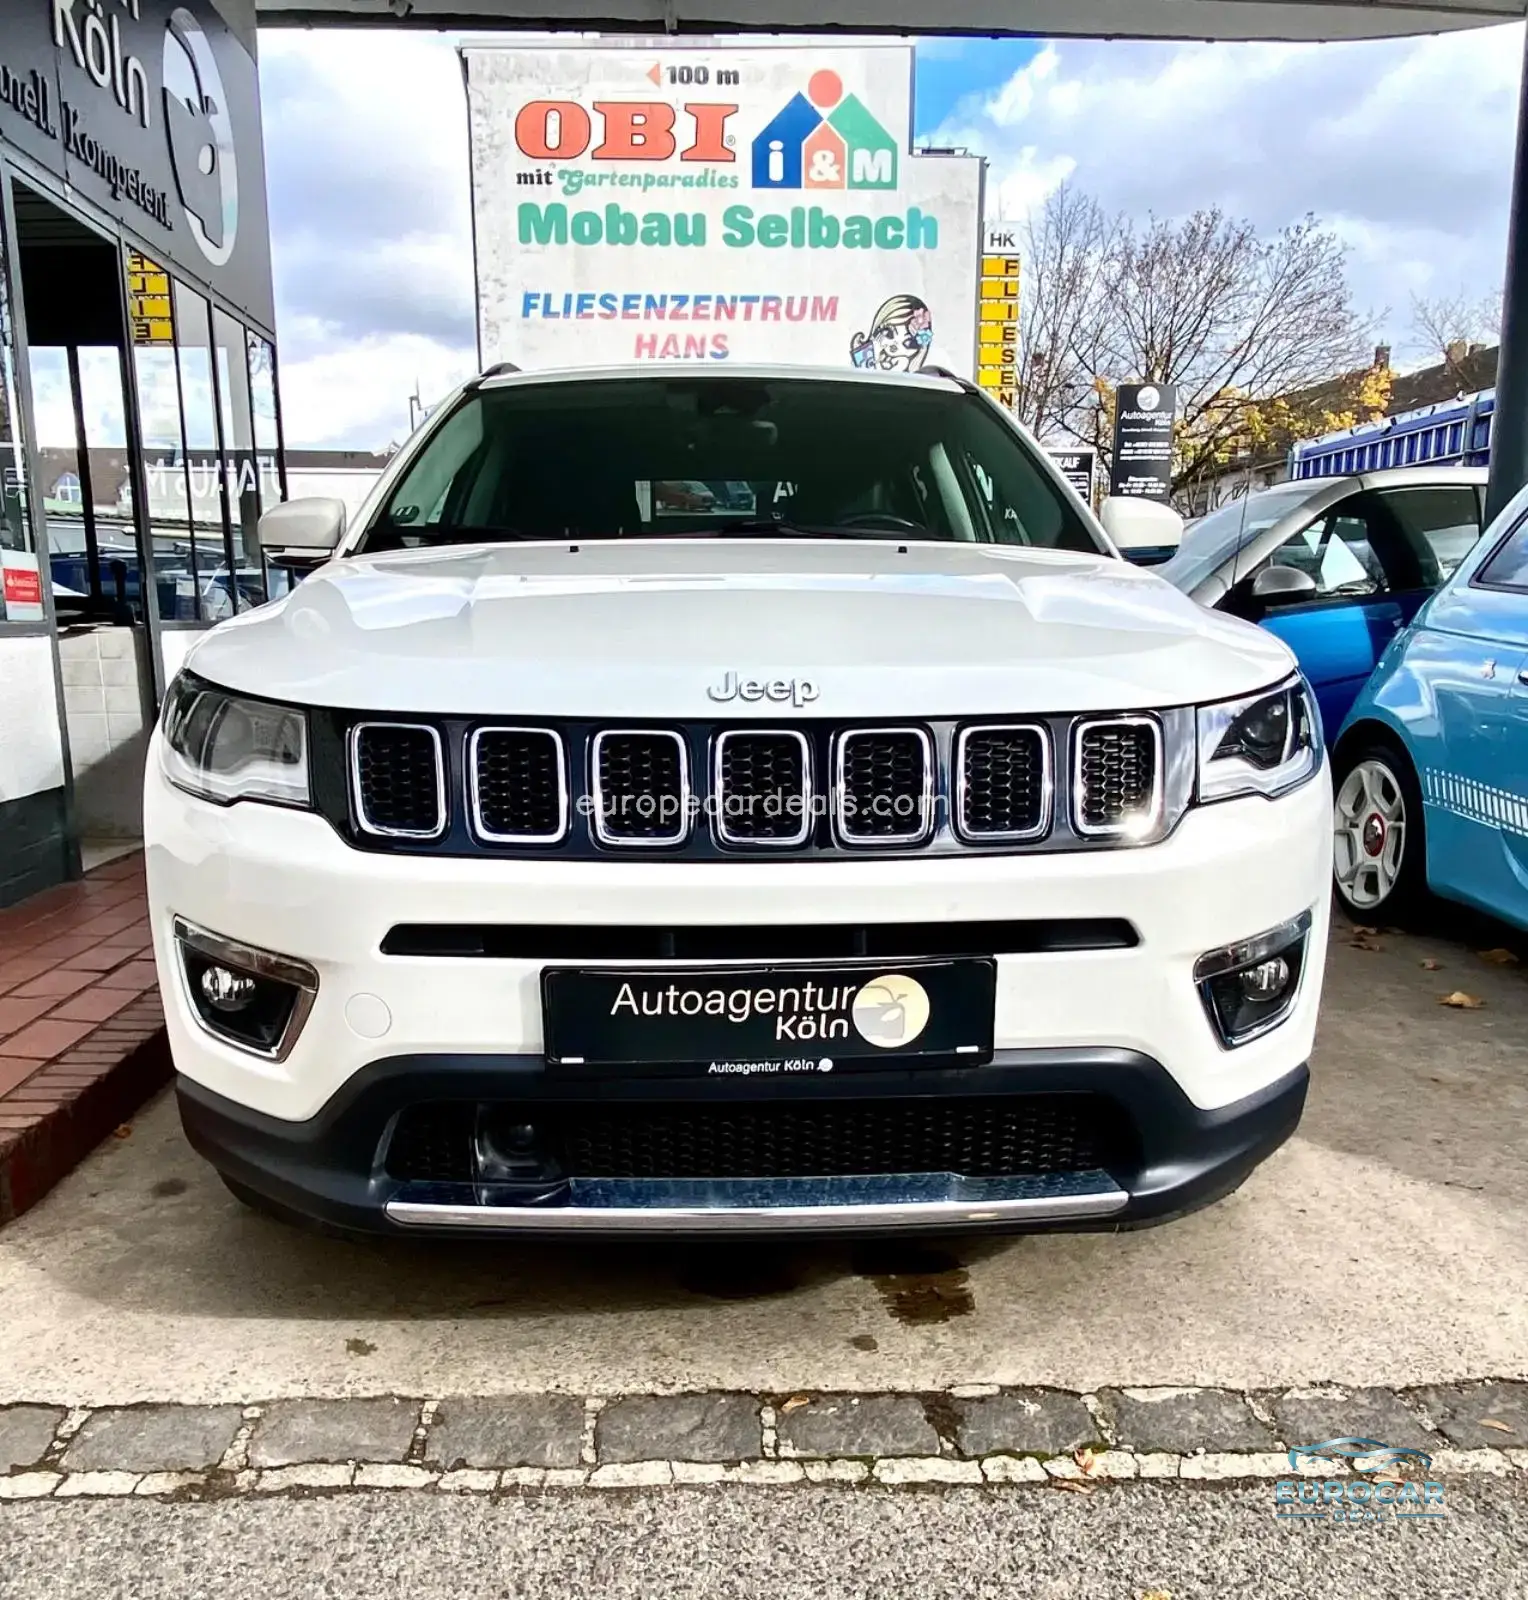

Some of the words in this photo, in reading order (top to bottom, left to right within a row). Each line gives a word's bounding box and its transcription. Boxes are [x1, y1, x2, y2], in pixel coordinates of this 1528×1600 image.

[54, 0, 150, 129] Köln
[666, 65, 709, 85] 100
[717, 69, 740, 85] m
[514, 100, 739, 162] OBI
[516, 168, 554, 186] mit
[557, 167, 739, 197] Gartenparadies
[517, 202, 707, 247] Mobau
[723, 205, 939, 250] Selbach
[989, 232, 1016, 248] HK
[521, 291, 841, 322] FLIESENZENTRUM
[634, 333, 730, 360] HANS
[1000, 259, 1019, 408] FLIESEN
[1120, 410, 1173, 422] Autoagentur
[707, 671, 820, 708] Jeep
[610, 982, 856, 1023] Autoagentur
[775, 1012, 850, 1040] Köln
[708, 1060, 780, 1076] Autoagentur
[783, 1058, 815, 1072] Köln
